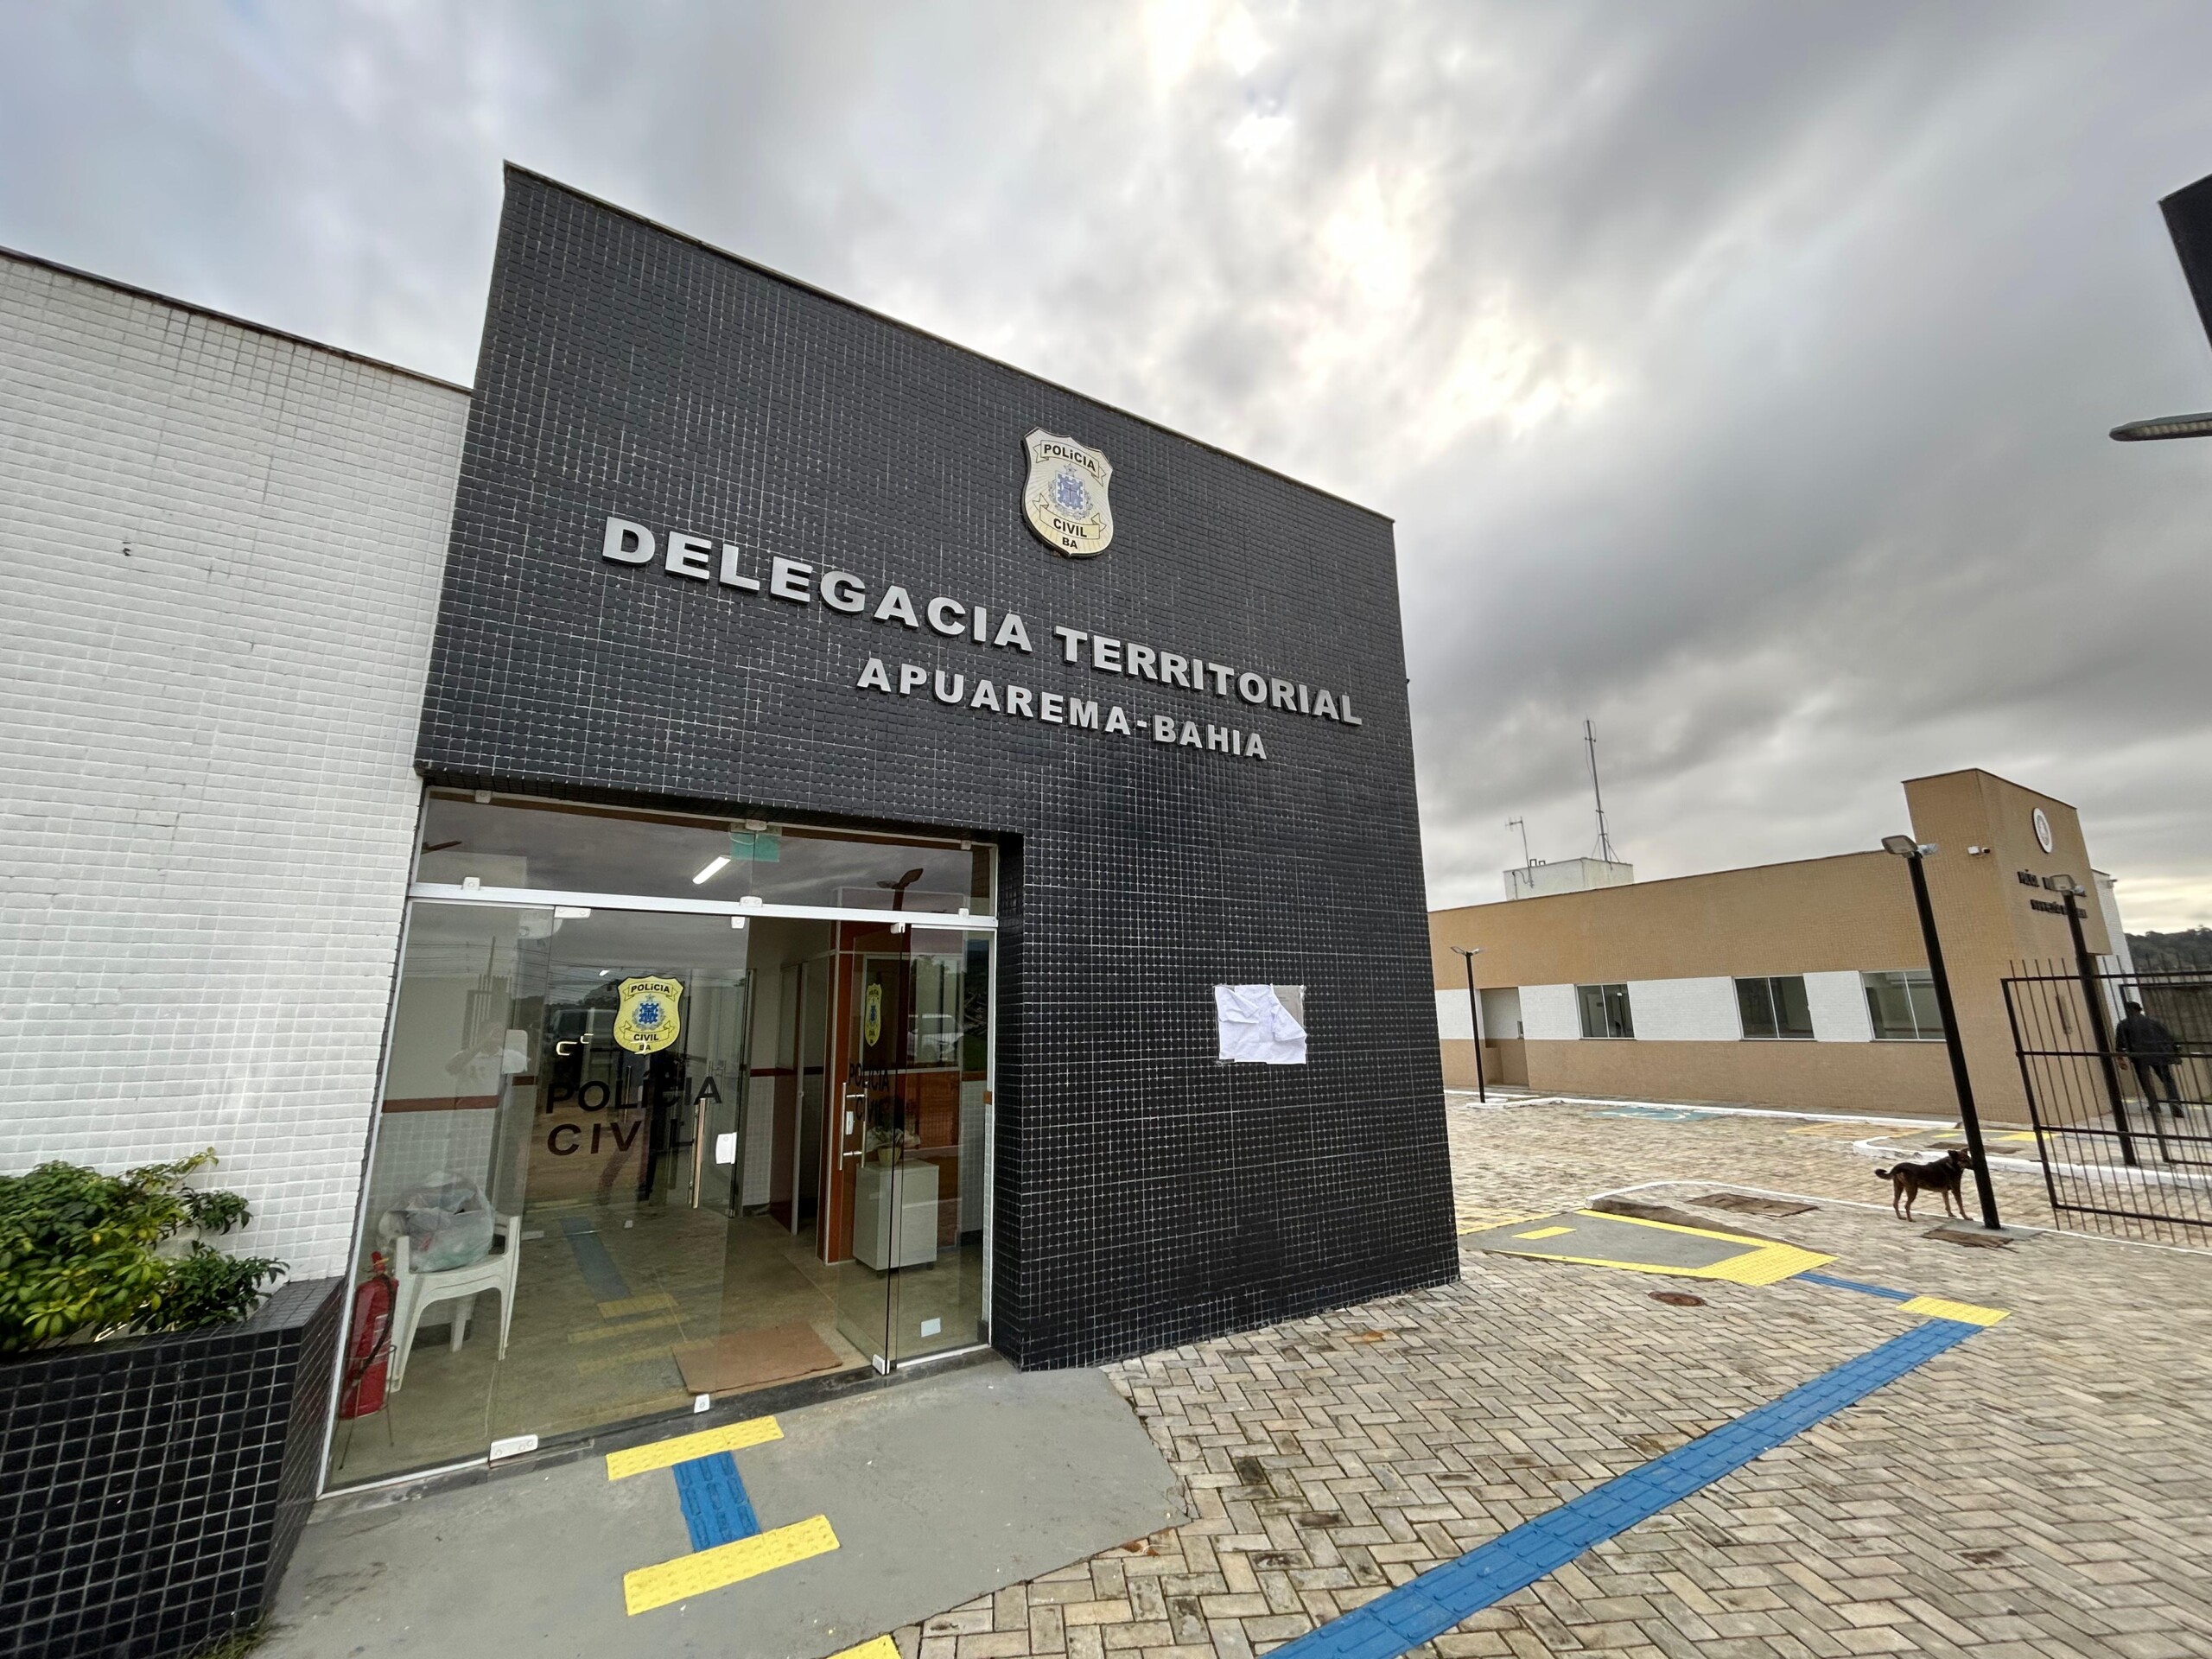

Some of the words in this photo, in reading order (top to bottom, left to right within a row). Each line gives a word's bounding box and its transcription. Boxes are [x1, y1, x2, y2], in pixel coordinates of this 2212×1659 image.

[1053, 518, 1087, 537] CIVIL
[1062, 537, 1077, 549] BA
[603, 517, 1033, 653] DELEGACIA
[1053, 626, 1363, 726] TERRITORIAL
[857, 658, 1267, 760] APUAREMA-BAHIA
[547, 1119, 695, 1156] CIVL
